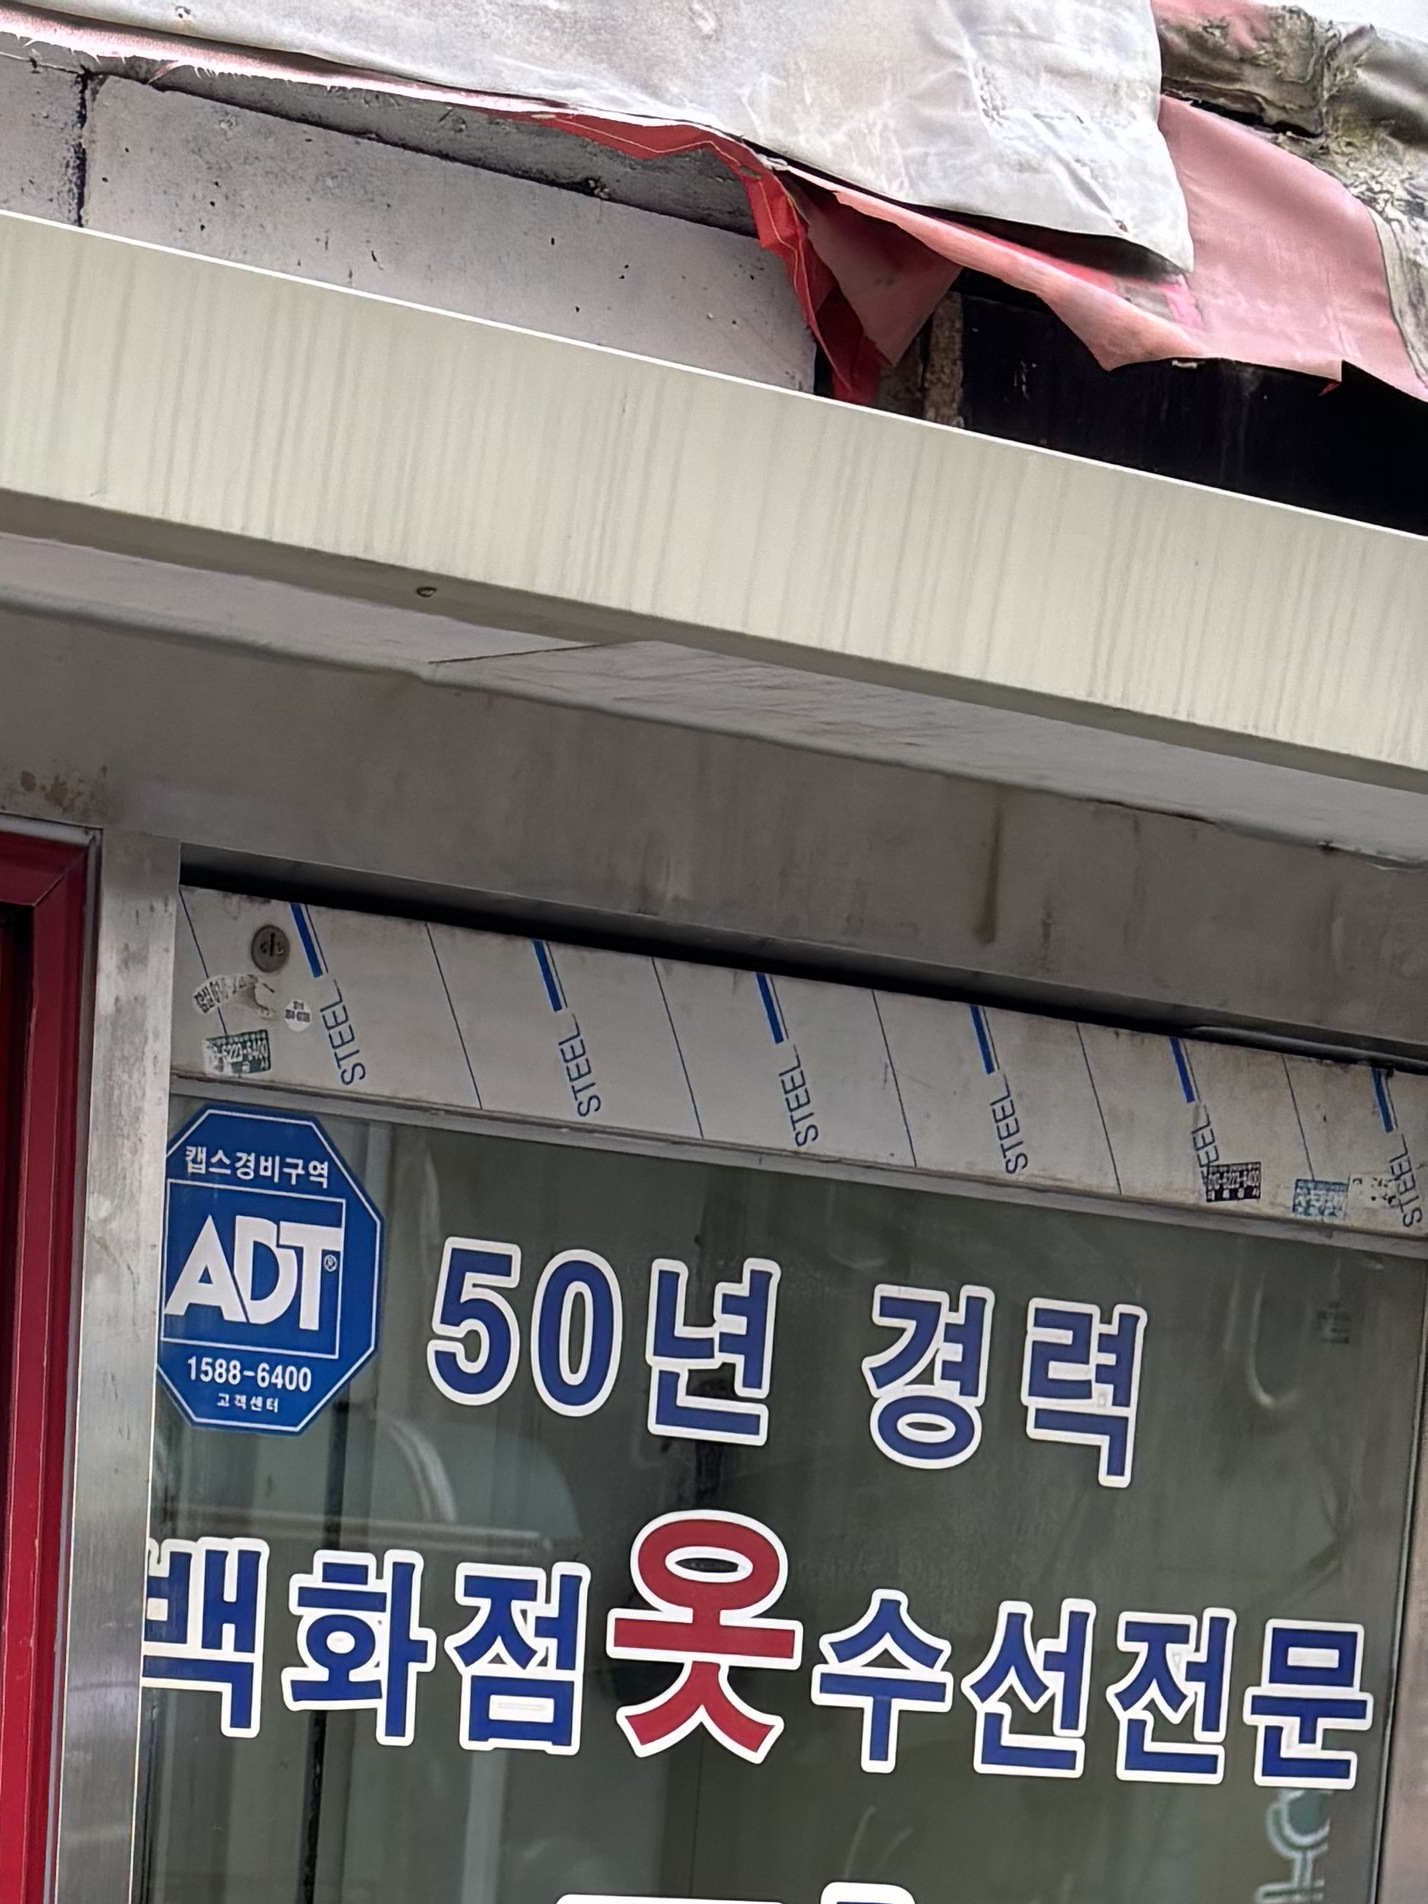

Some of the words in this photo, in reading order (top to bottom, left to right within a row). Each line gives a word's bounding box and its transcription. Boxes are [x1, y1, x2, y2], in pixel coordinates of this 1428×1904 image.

[319, 978, 367, 1087] STEEL
[559, 1007, 602, 1118] STEEL
[777, 1044, 820, 1148] STEEL
[989, 1073, 1028, 1175] STEEL
[184, 1145, 330, 1189] 캡스경비구역
[164, 1214, 344, 1331] ADT
[186, 1355, 312, 1392] 1588-6400
[216, 1393, 280, 1413] 고객센터
[427, 1236, 782, 1447] 50년
[861, 1283, 1147, 1488] 경력
